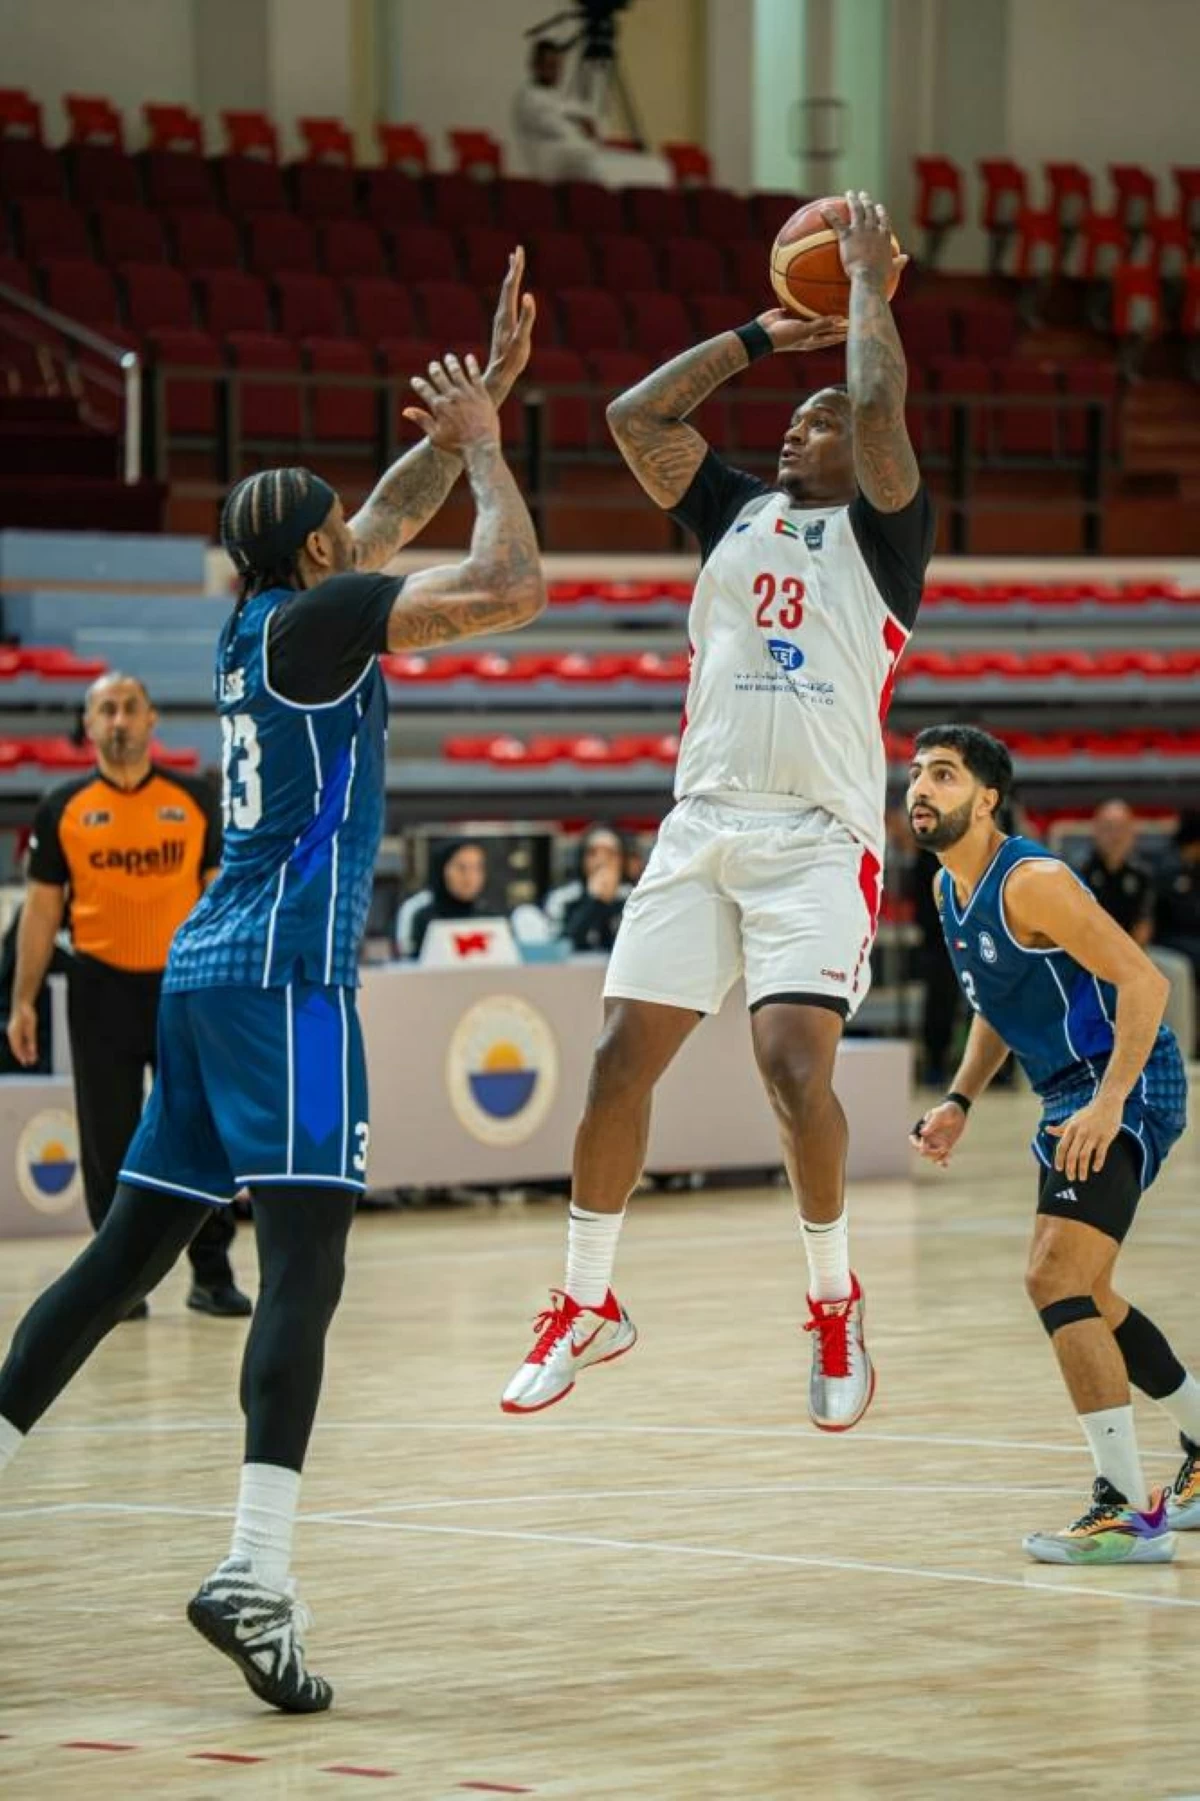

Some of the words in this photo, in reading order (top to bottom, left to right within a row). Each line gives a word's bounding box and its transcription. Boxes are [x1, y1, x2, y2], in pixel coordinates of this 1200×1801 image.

[753, 573, 806, 629] 23
[89, 840, 185, 876] capelli
[961, 970, 981, 1011] 2
[353, 1120, 369, 1172] 3
